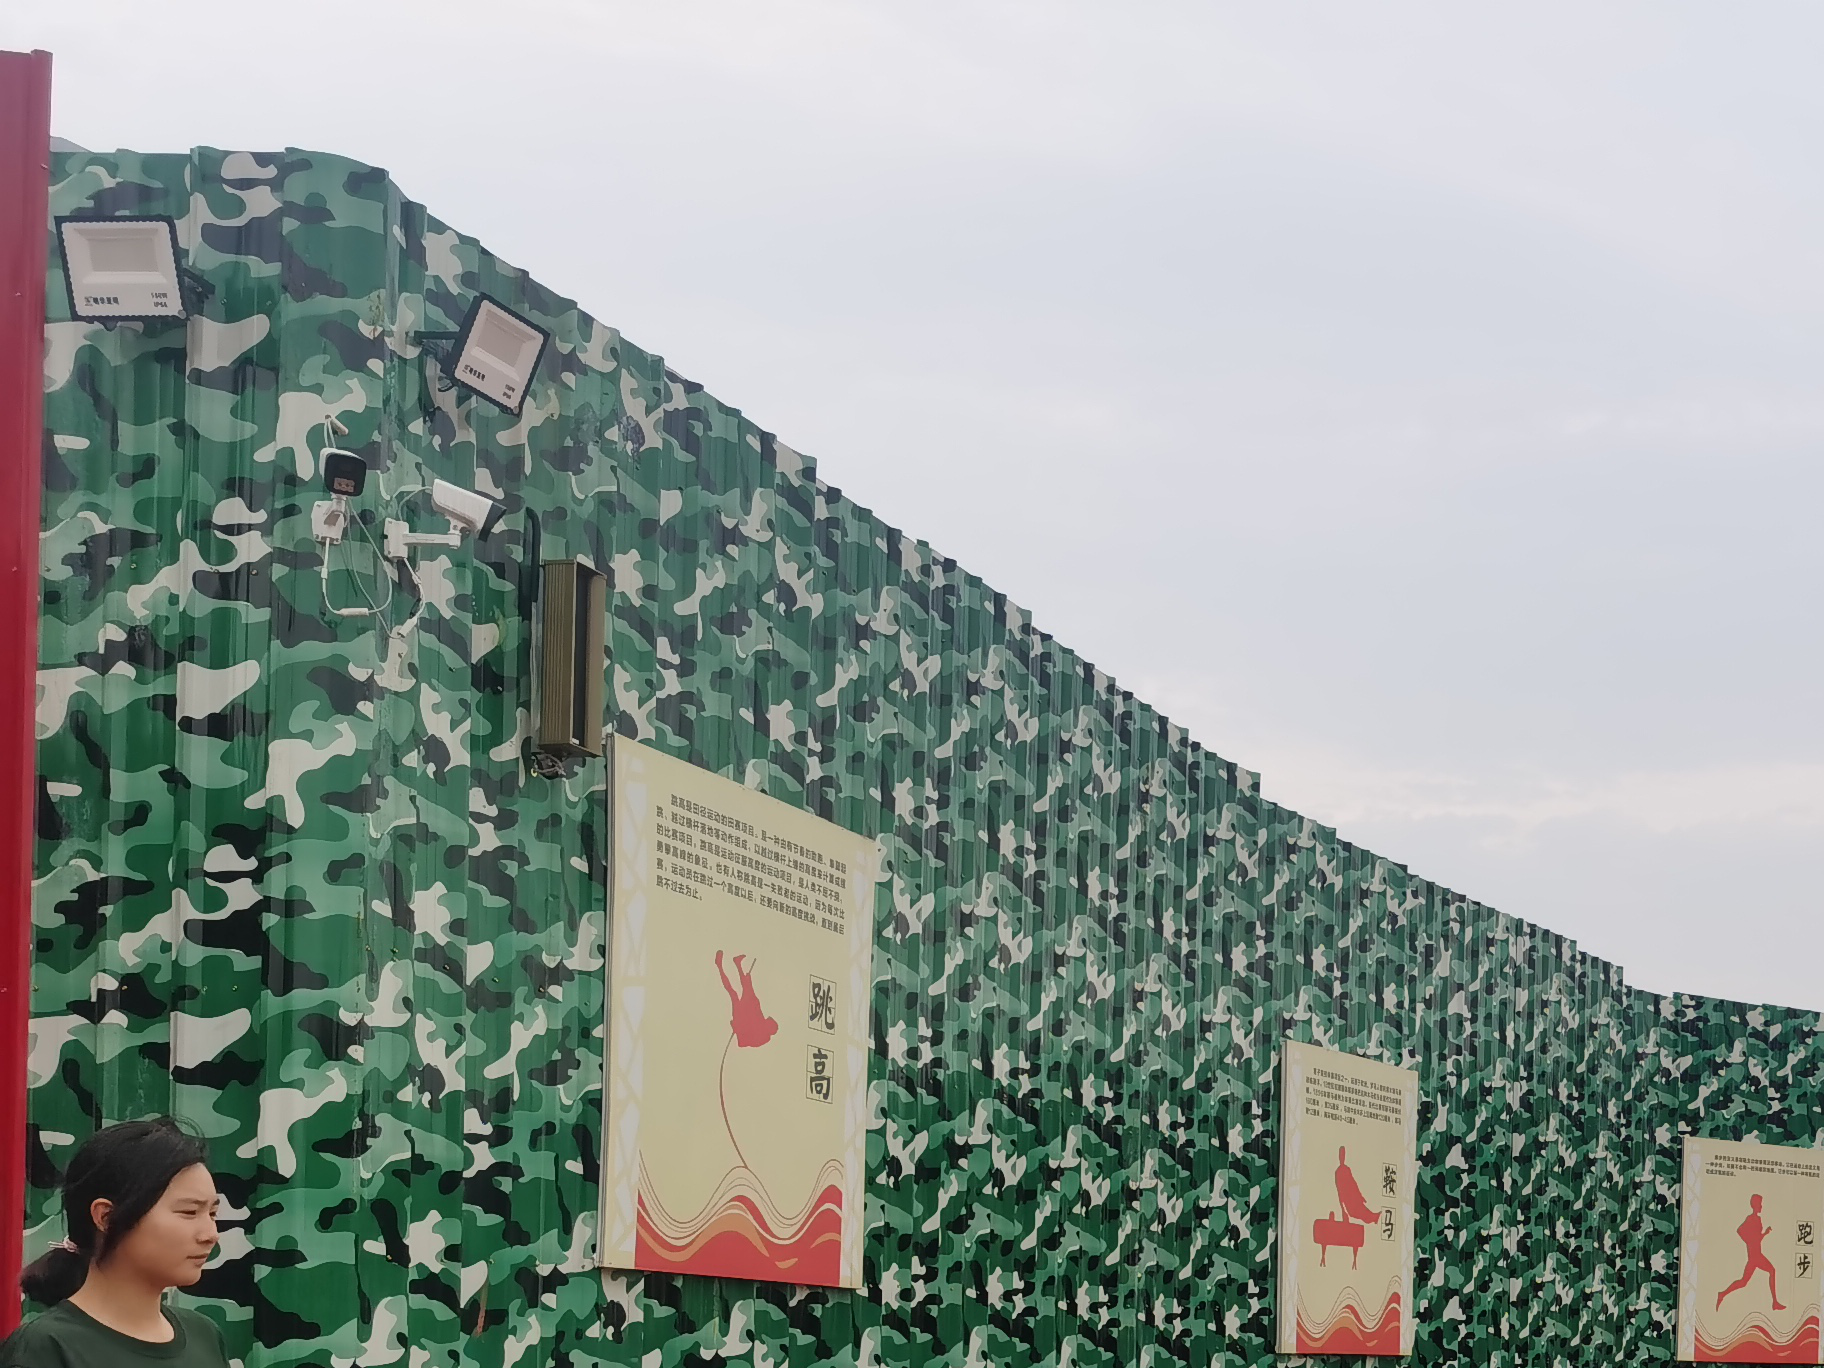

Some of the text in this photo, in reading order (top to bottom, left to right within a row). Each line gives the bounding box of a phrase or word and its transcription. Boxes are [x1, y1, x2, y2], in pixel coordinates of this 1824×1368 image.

[808, 979, 836, 1101] 跳高
[1383, 1166, 1397, 1240] 鞍马
[1796, 1222, 1813, 1278] 跑步
